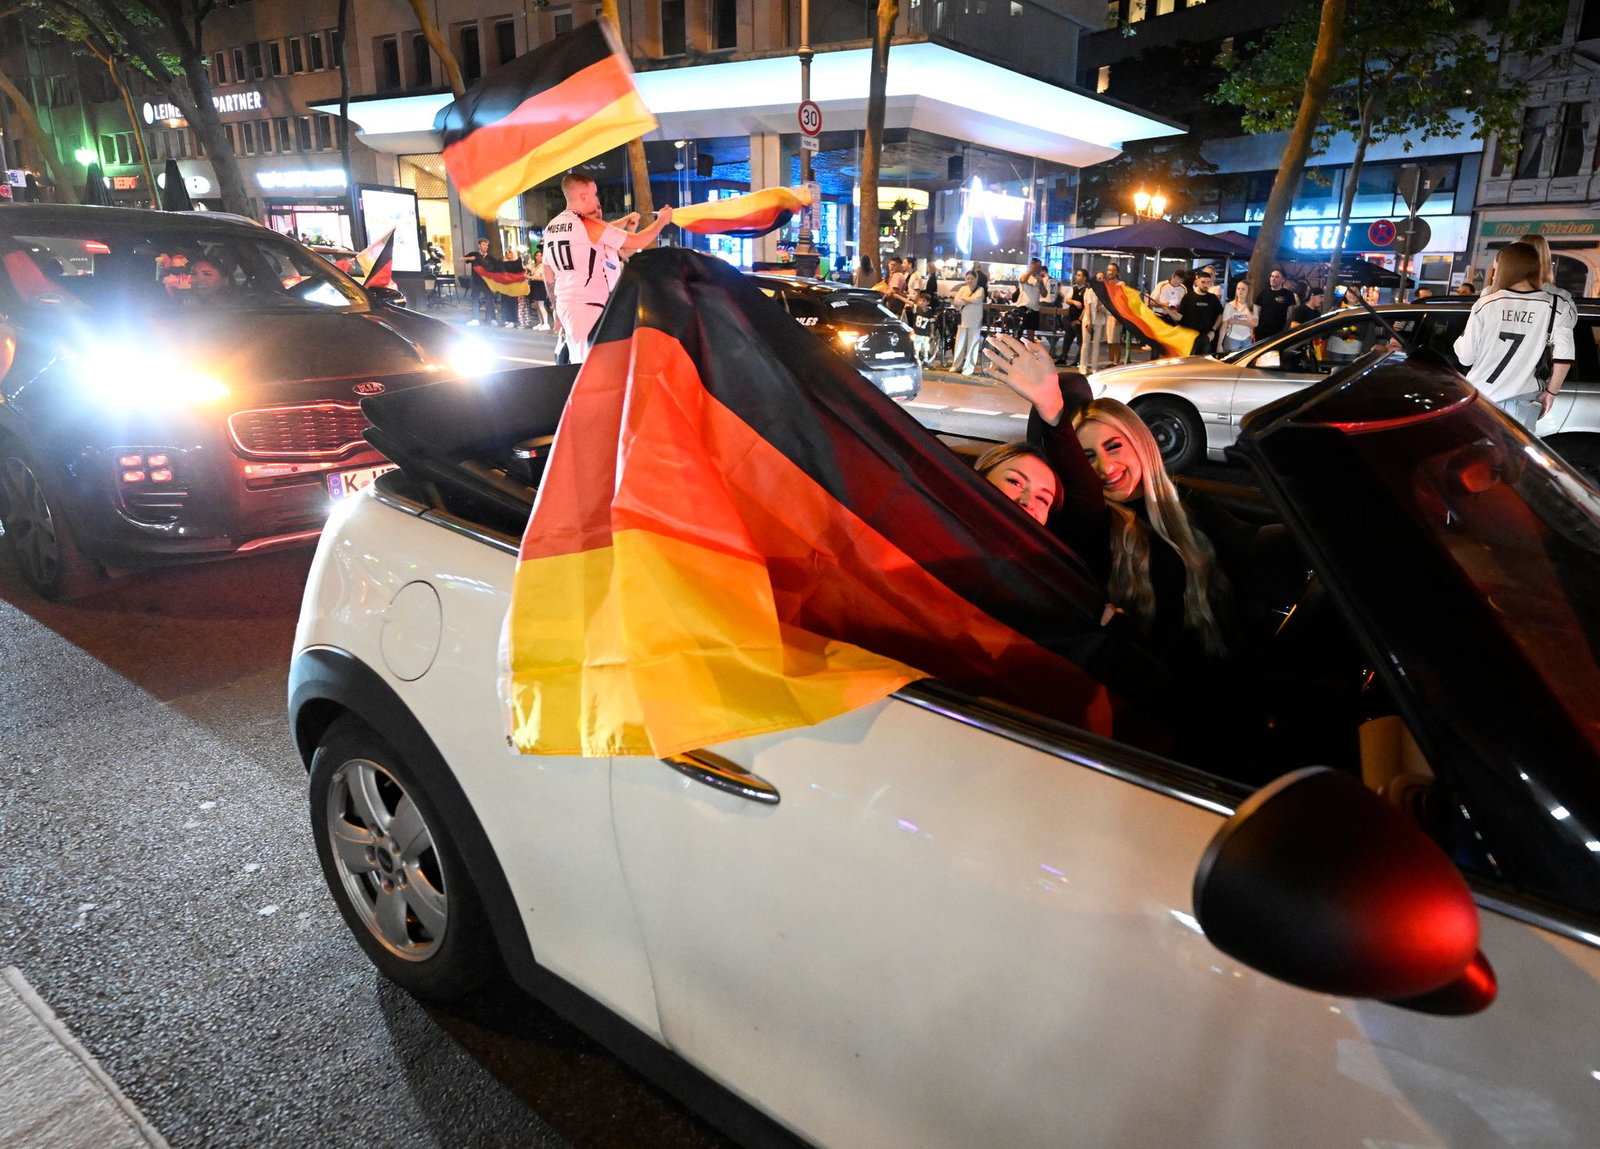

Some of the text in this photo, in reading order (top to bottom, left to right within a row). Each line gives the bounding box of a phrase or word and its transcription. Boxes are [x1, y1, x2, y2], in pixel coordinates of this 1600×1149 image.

[212, 91, 262, 113] PARTNER
[803, 109, 817, 127] 30
[547, 222, 573, 234] MUSIALA
[547, 240, 574, 271] 10
[915, 315, 930, 329] 87
[1502, 309, 1535, 324] LENZE
[1485, 331, 1526, 384] 7
[356, 384, 382, 393] KIA
[344, 473, 359, 494] K
